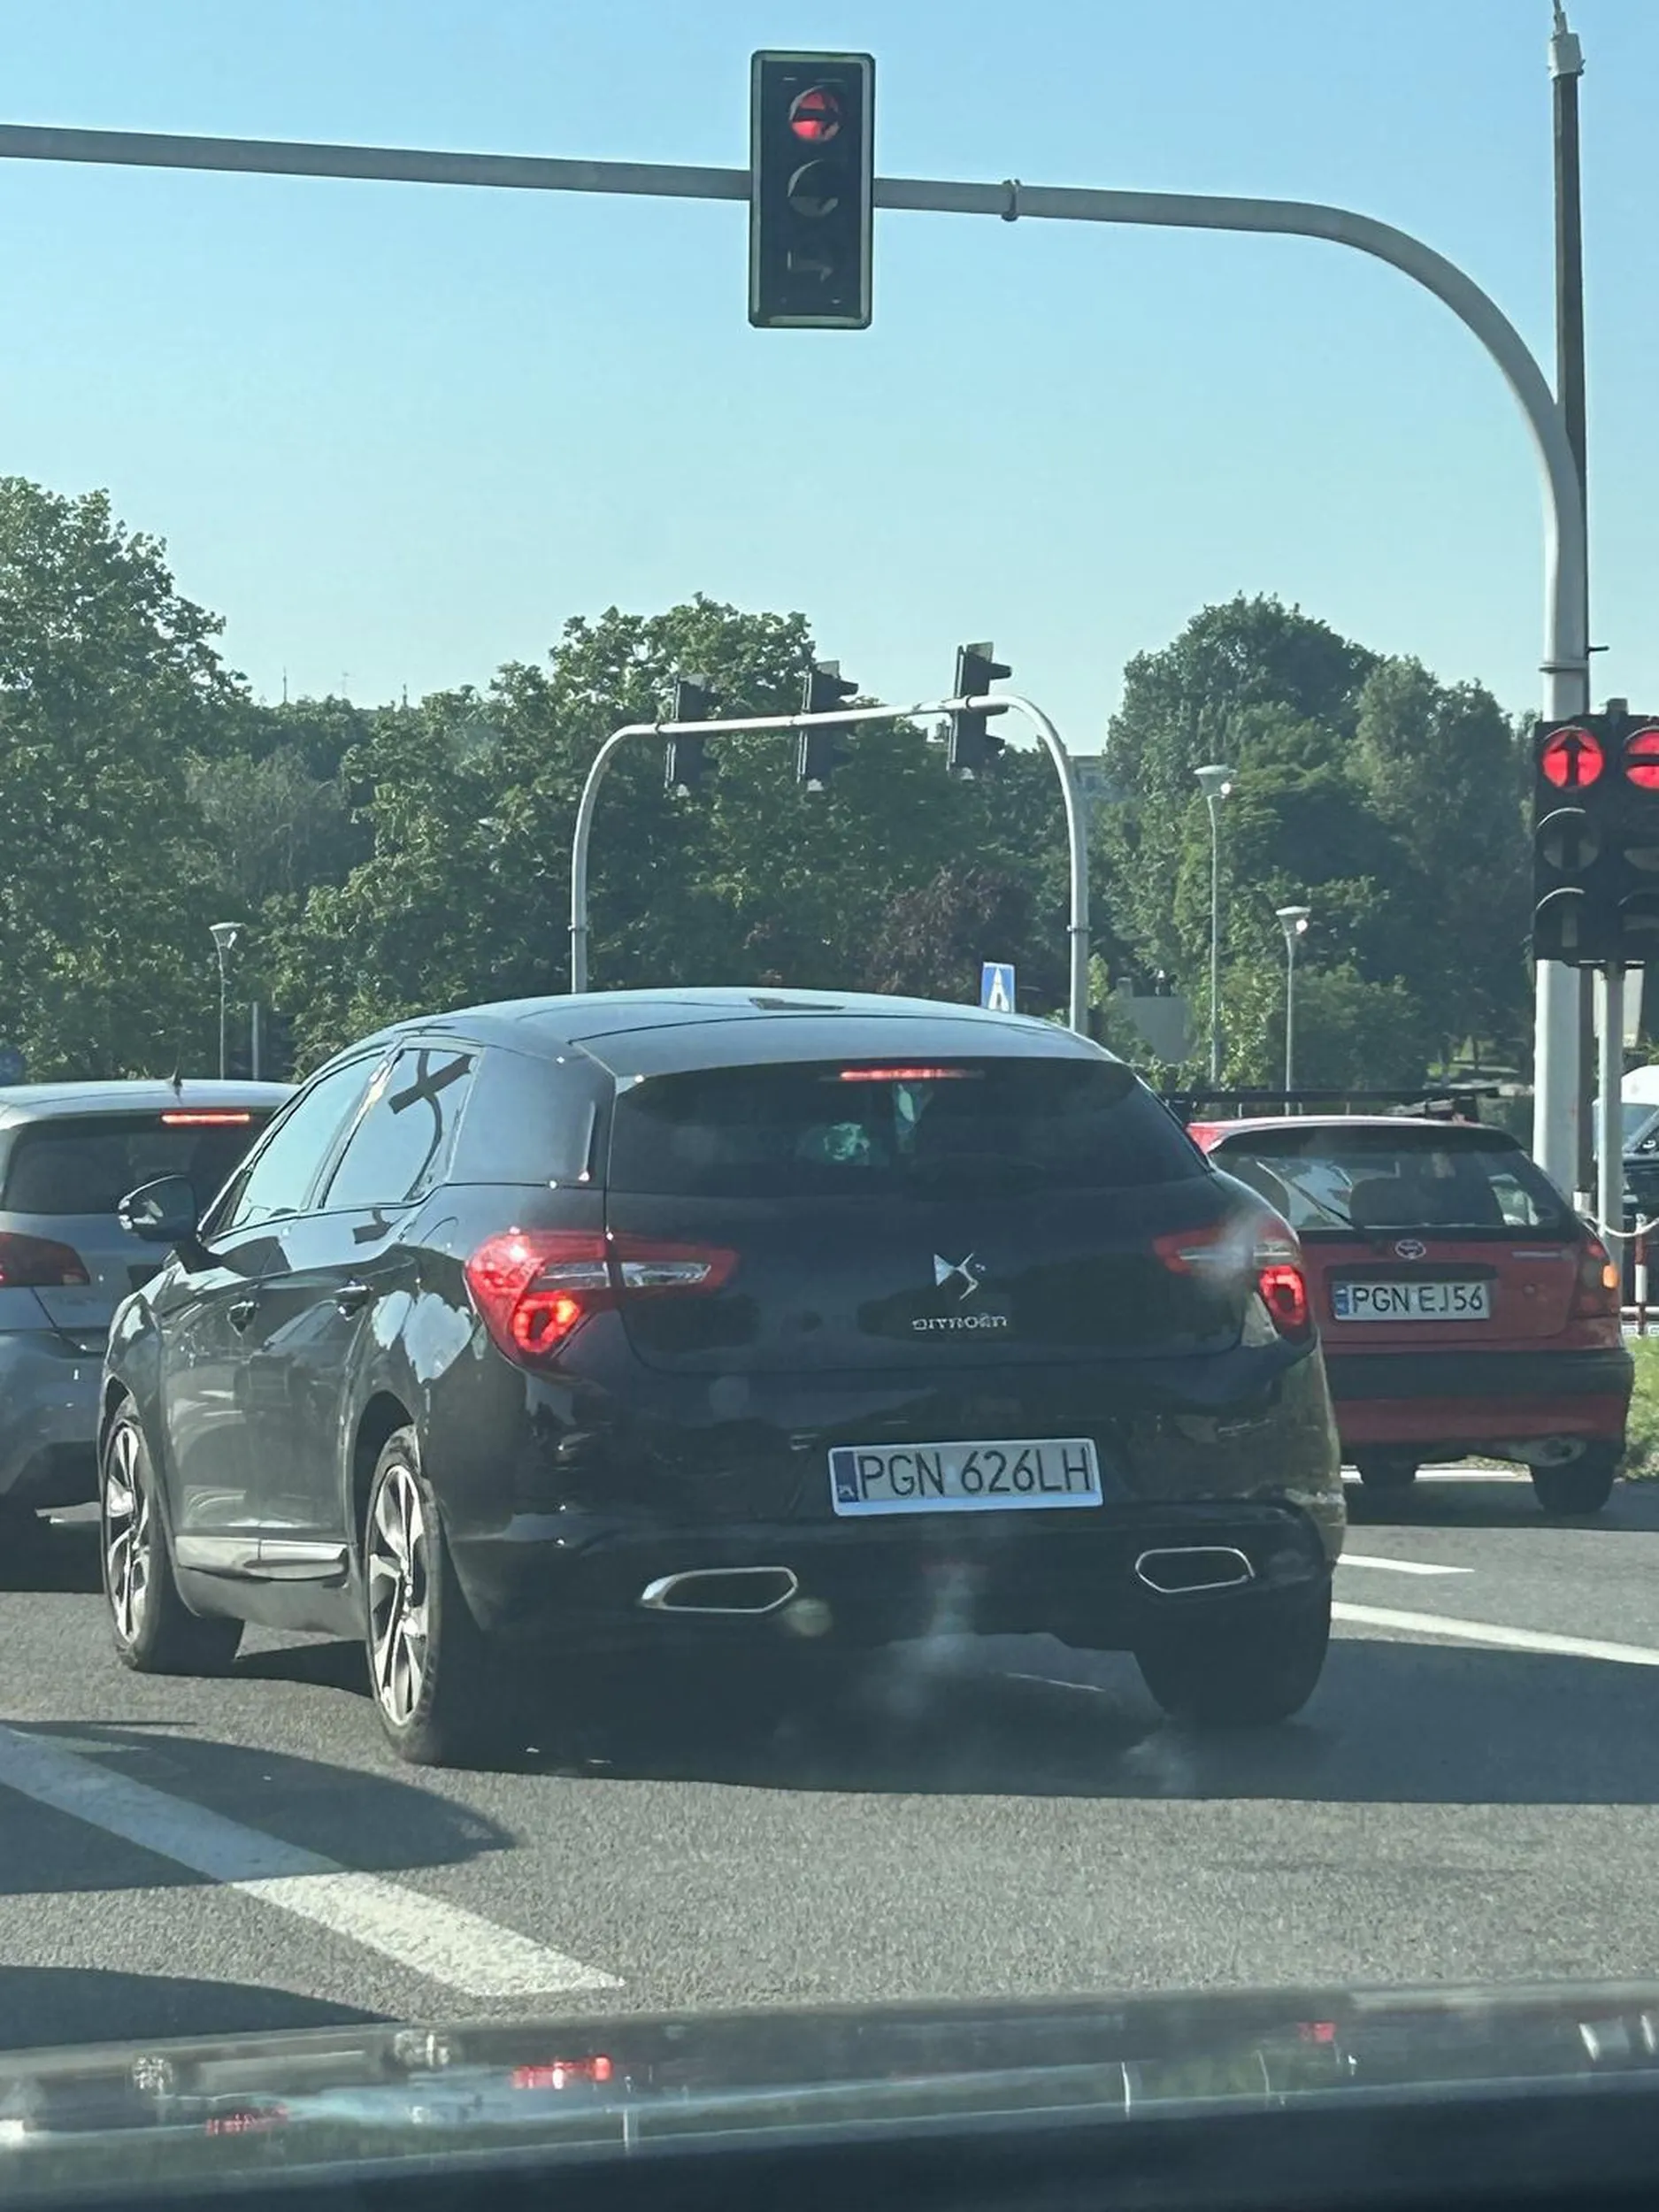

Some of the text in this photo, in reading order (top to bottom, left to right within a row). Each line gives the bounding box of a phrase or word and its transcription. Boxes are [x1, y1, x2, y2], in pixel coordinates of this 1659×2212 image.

[1352, 1286, 1409, 1313] PGN
[1418, 1286, 1484, 1312] EJ56
[857, 1448, 1091, 1499] PGN 626LH
